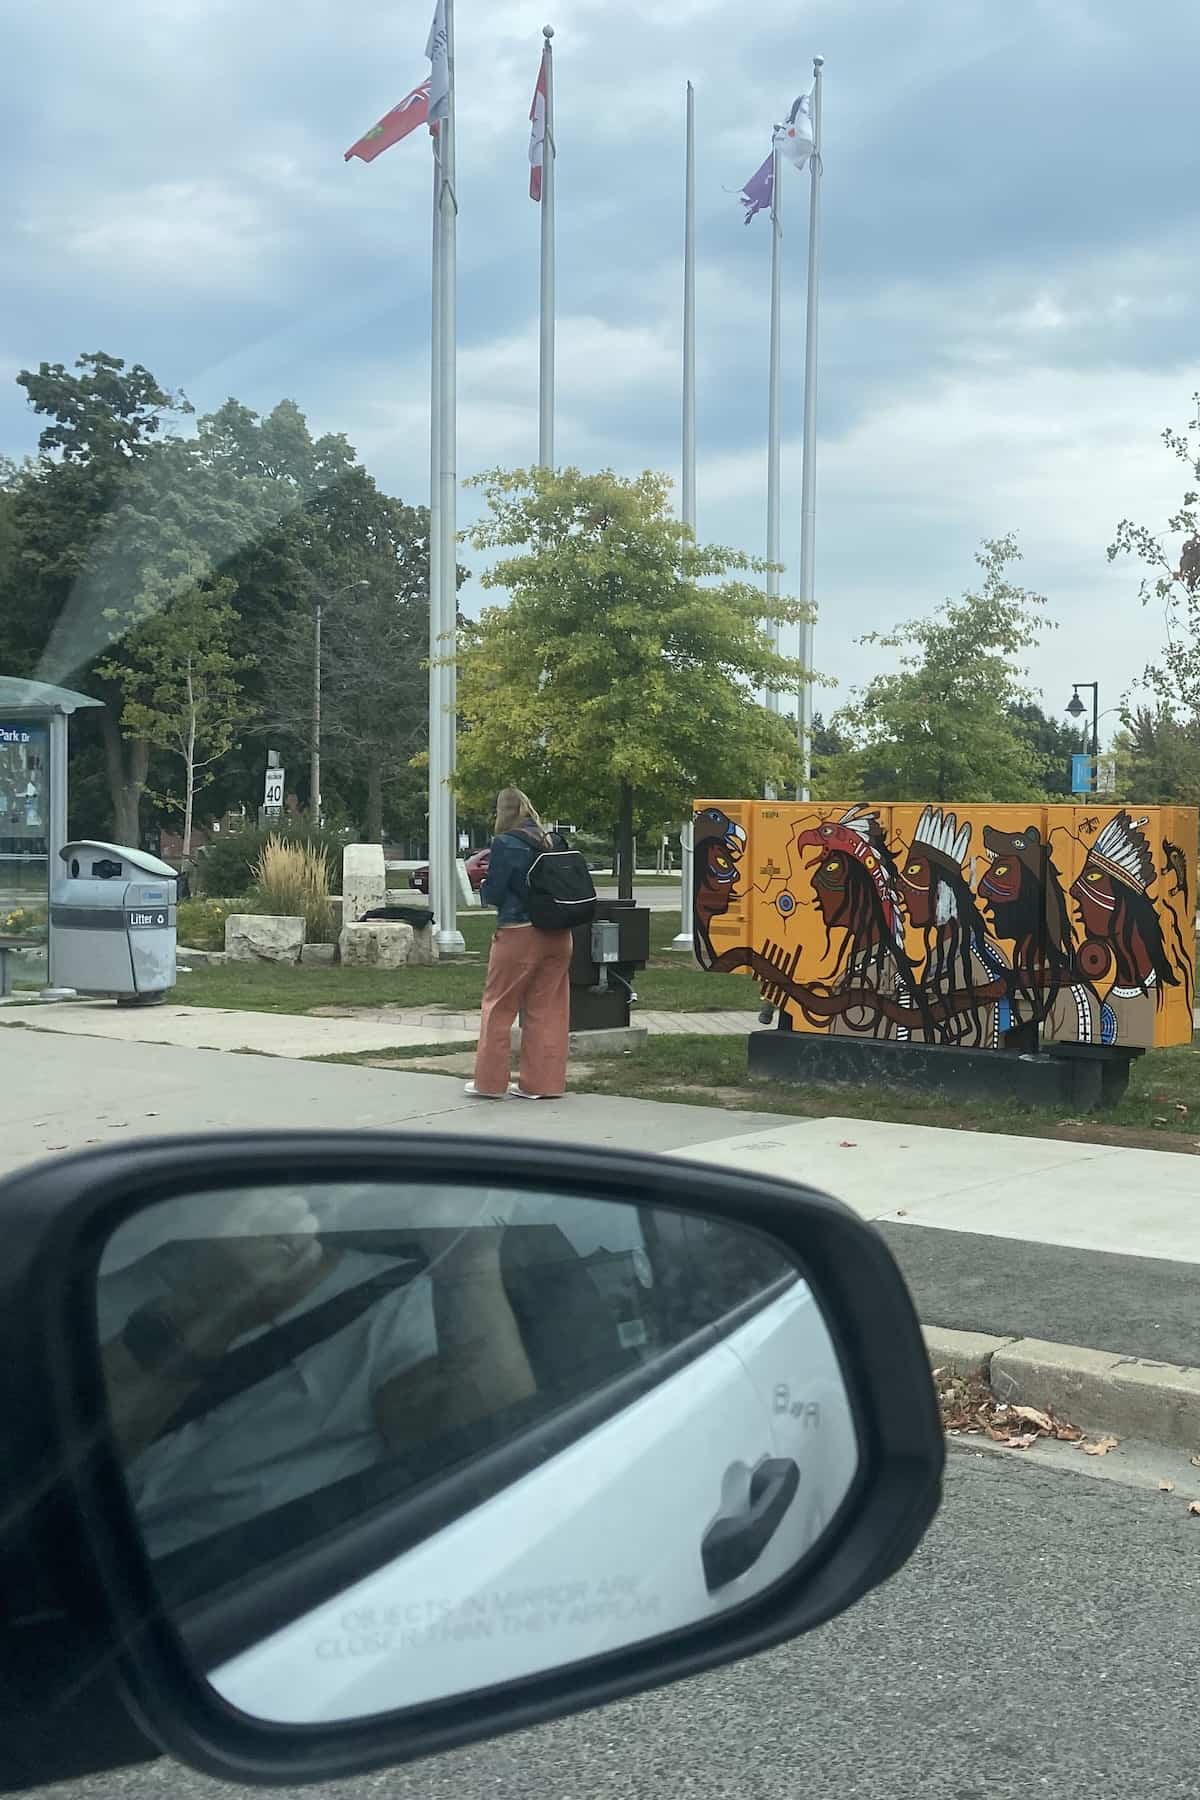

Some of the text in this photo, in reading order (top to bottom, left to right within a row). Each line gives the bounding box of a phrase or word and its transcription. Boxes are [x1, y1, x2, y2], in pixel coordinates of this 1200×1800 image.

[22, 733, 31, 742] Dr
[266, 785, 281, 802] 40
[131, 913, 152, 925] Litter
